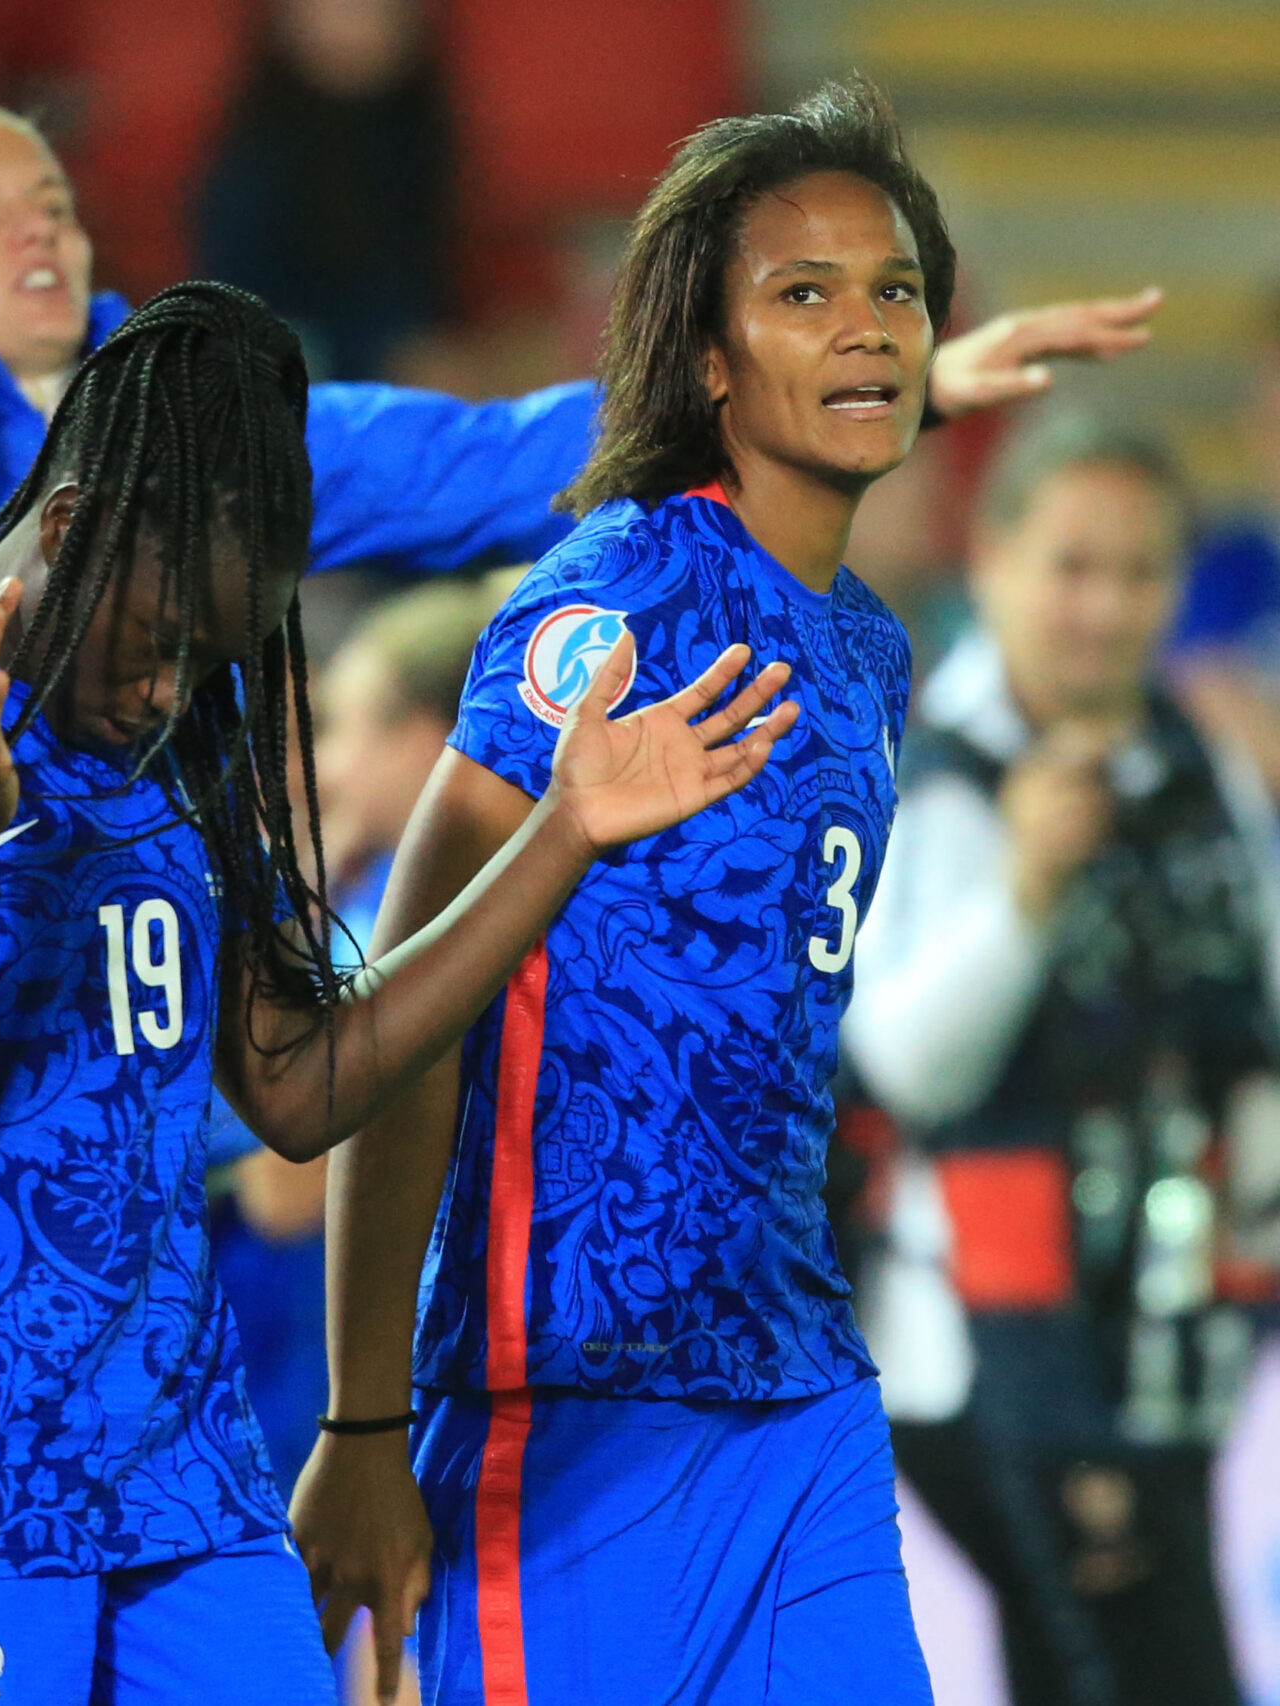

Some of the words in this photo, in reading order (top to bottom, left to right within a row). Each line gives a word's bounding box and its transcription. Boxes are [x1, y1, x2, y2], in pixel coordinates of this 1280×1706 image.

[523, 688, 564, 725] ENGLAND
[808, 826, 862, 974] 3
[98, 898, 183, 1056] 19
